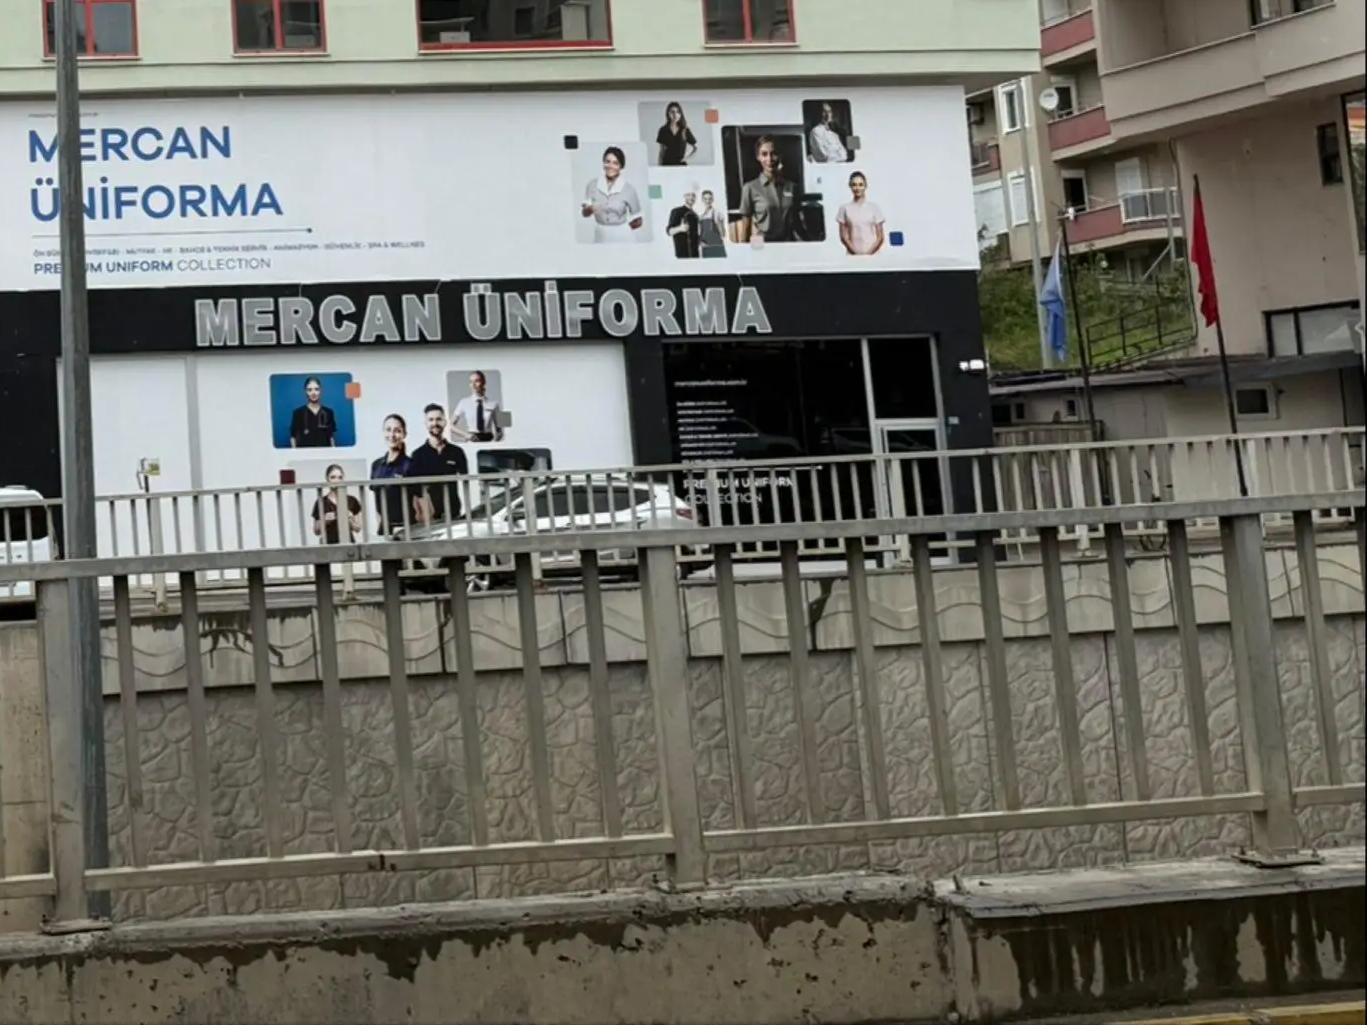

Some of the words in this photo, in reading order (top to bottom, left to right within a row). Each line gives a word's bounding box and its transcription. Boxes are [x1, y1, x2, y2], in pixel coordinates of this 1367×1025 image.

[28, 126, 232, 163] MERCAN
[34, 262, 103, 274] PREM
[106, 260, 173, 273] UNIFORM
[177, 257, 271, 272] COLLECTION
[194, 292, 442, 347] MERCAN
[463, 280, 773, 341] ÜNİFORMA
